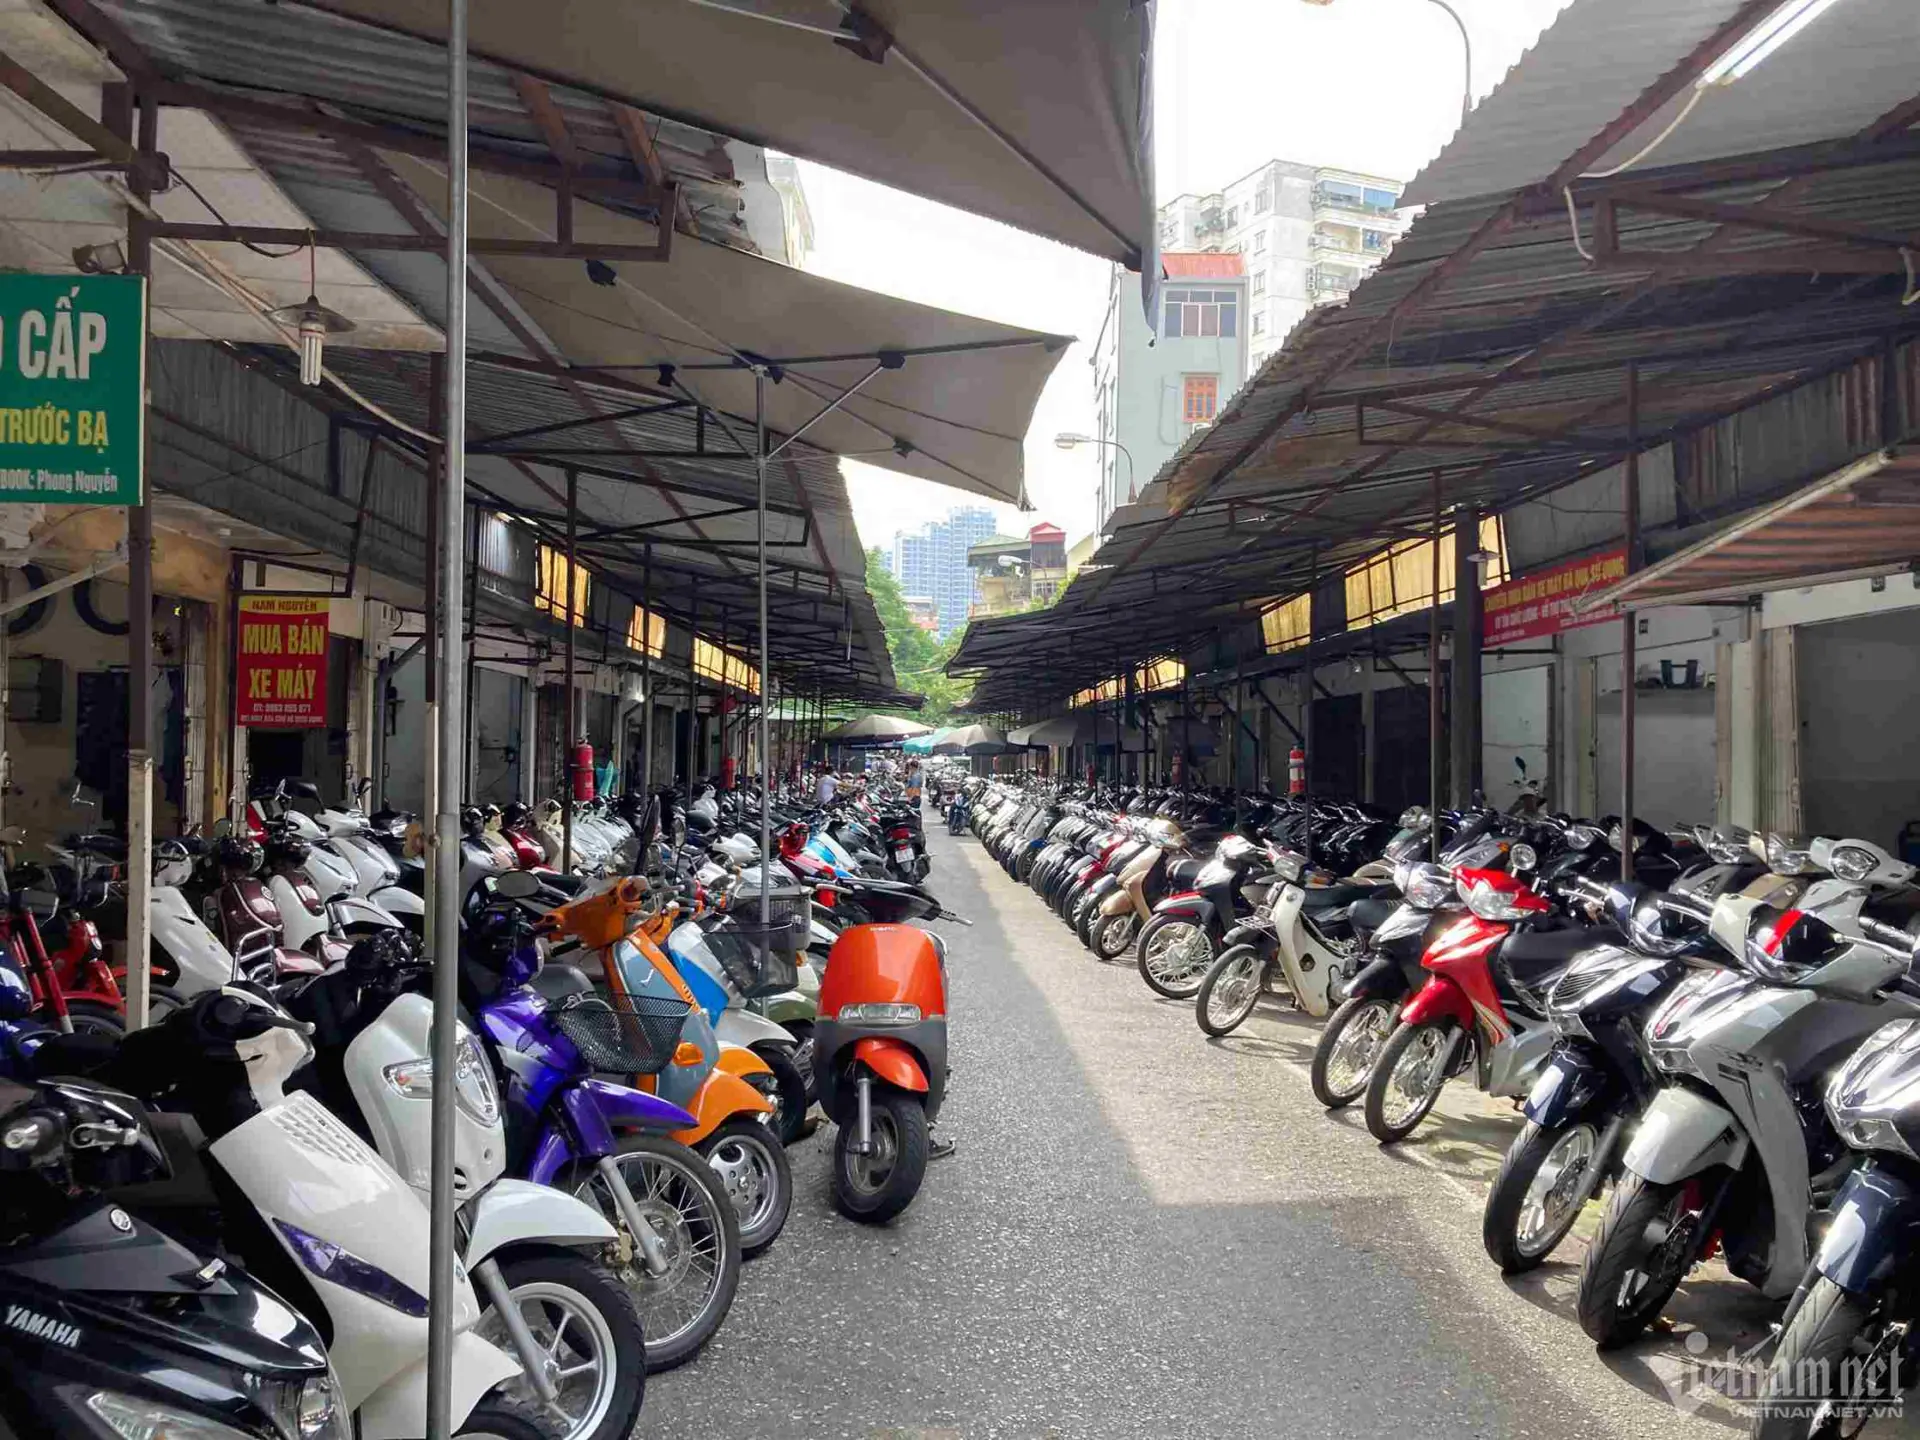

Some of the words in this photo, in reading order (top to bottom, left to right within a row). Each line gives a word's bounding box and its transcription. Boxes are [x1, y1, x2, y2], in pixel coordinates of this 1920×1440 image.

[18, 286, 107, 379] CẤP
[77, 409, 109, 453] BẠ
[37, 469, 73, 493] Phong
[243, 624, 282, 654] MUA
[287, 618, 325, 655] BÁN
[248, 668, 272, 699] XE
[277, 663, 316, 699] MÁY
[4, 1304, 82, 1348] YAMAHA
